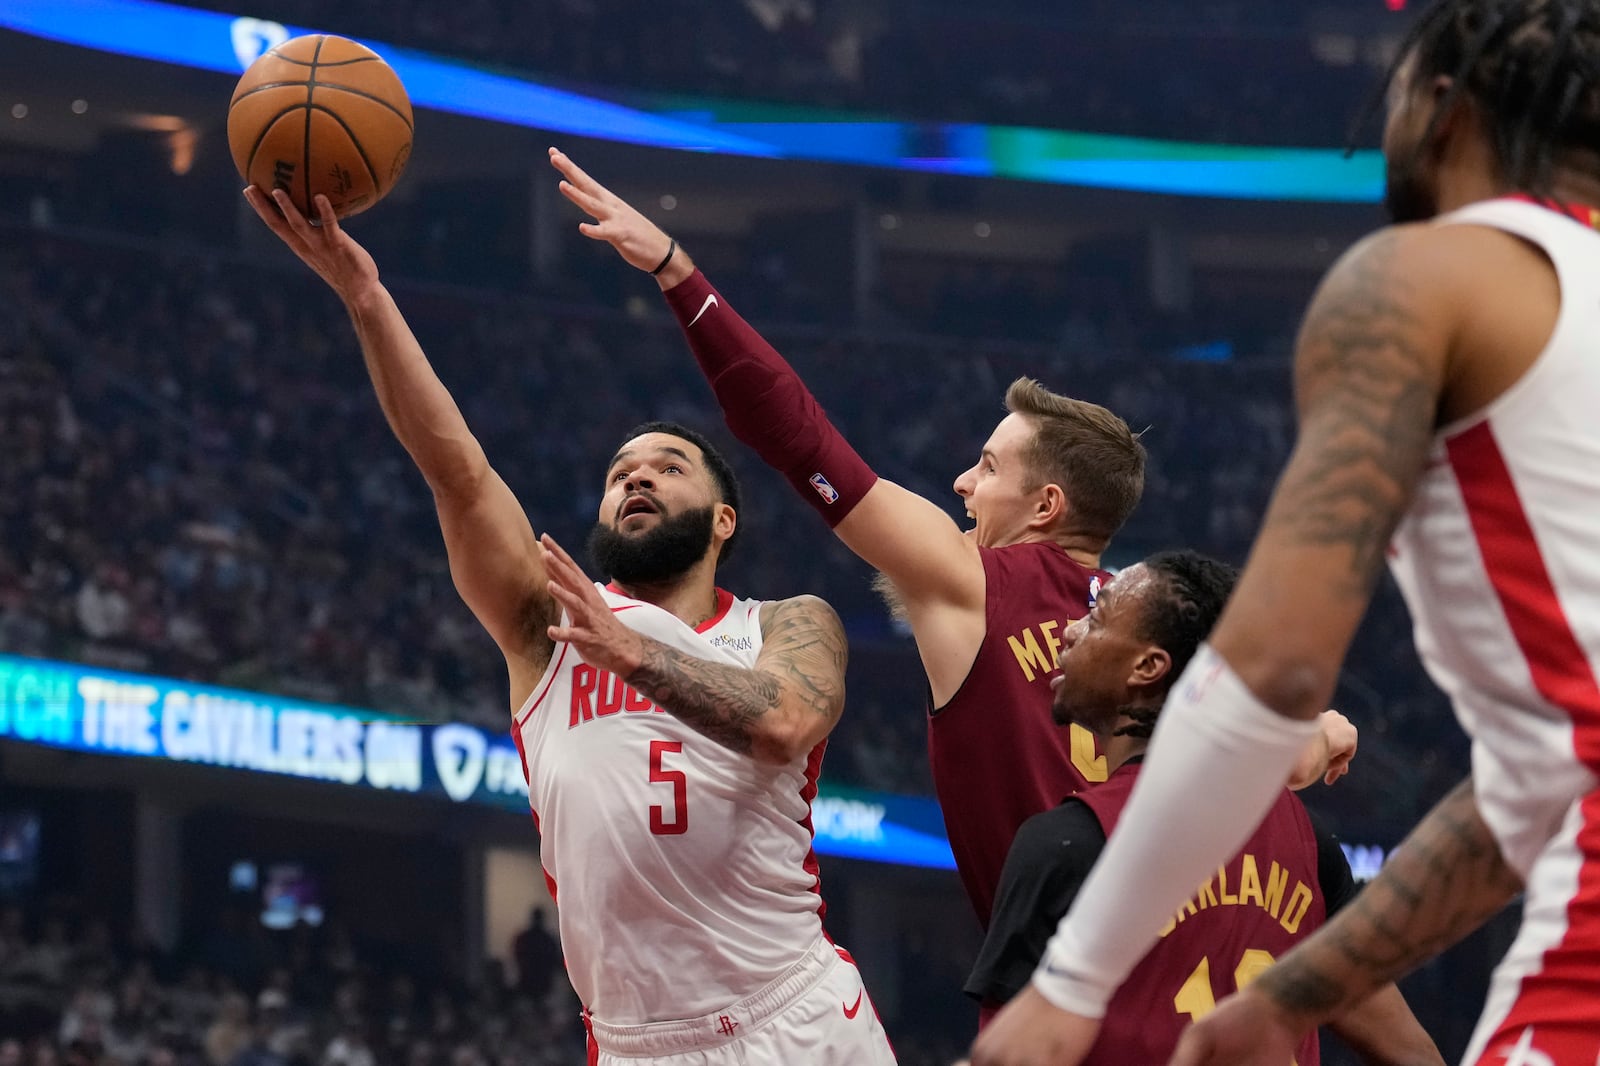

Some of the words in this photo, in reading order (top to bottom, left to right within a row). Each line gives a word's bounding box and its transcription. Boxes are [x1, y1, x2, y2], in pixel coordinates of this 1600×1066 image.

[77, 676, 159, 754] THE
[161, 690, 363, 784] CAVALIERS
[365, 720, 422, 791] ON
[649, 740, 688, 835] 5
